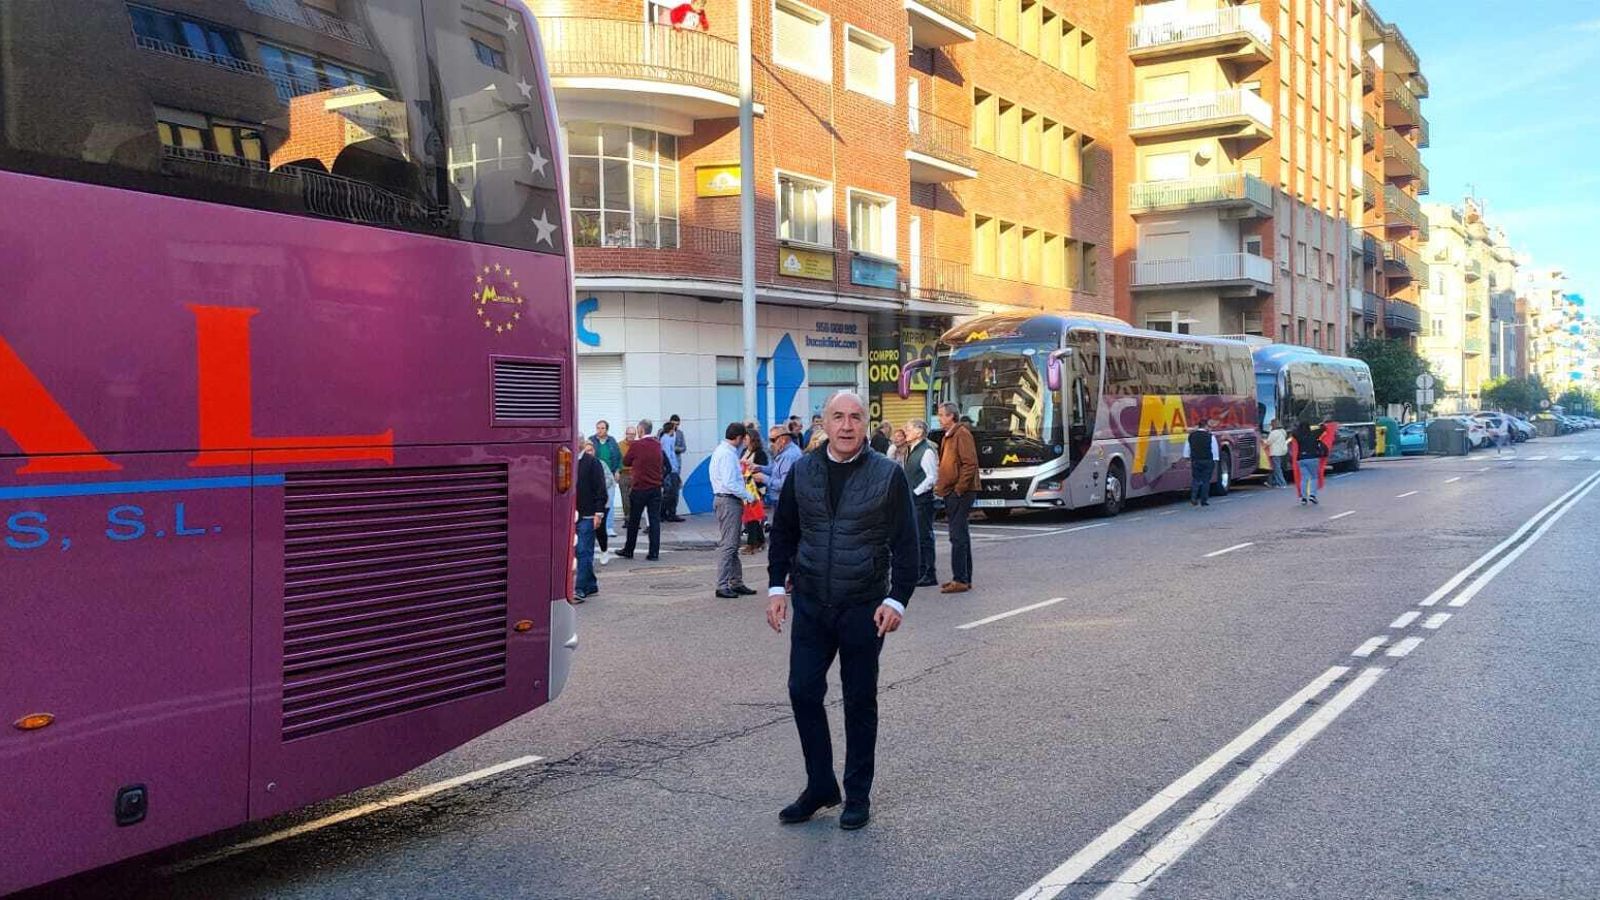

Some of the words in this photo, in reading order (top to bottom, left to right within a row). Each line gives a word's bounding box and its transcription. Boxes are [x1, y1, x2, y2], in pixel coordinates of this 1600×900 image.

[869, 350, 899, 361] COMPRO
[869, 364, 900, 382] ORO
[105, 503, 223, 541] S.L.
